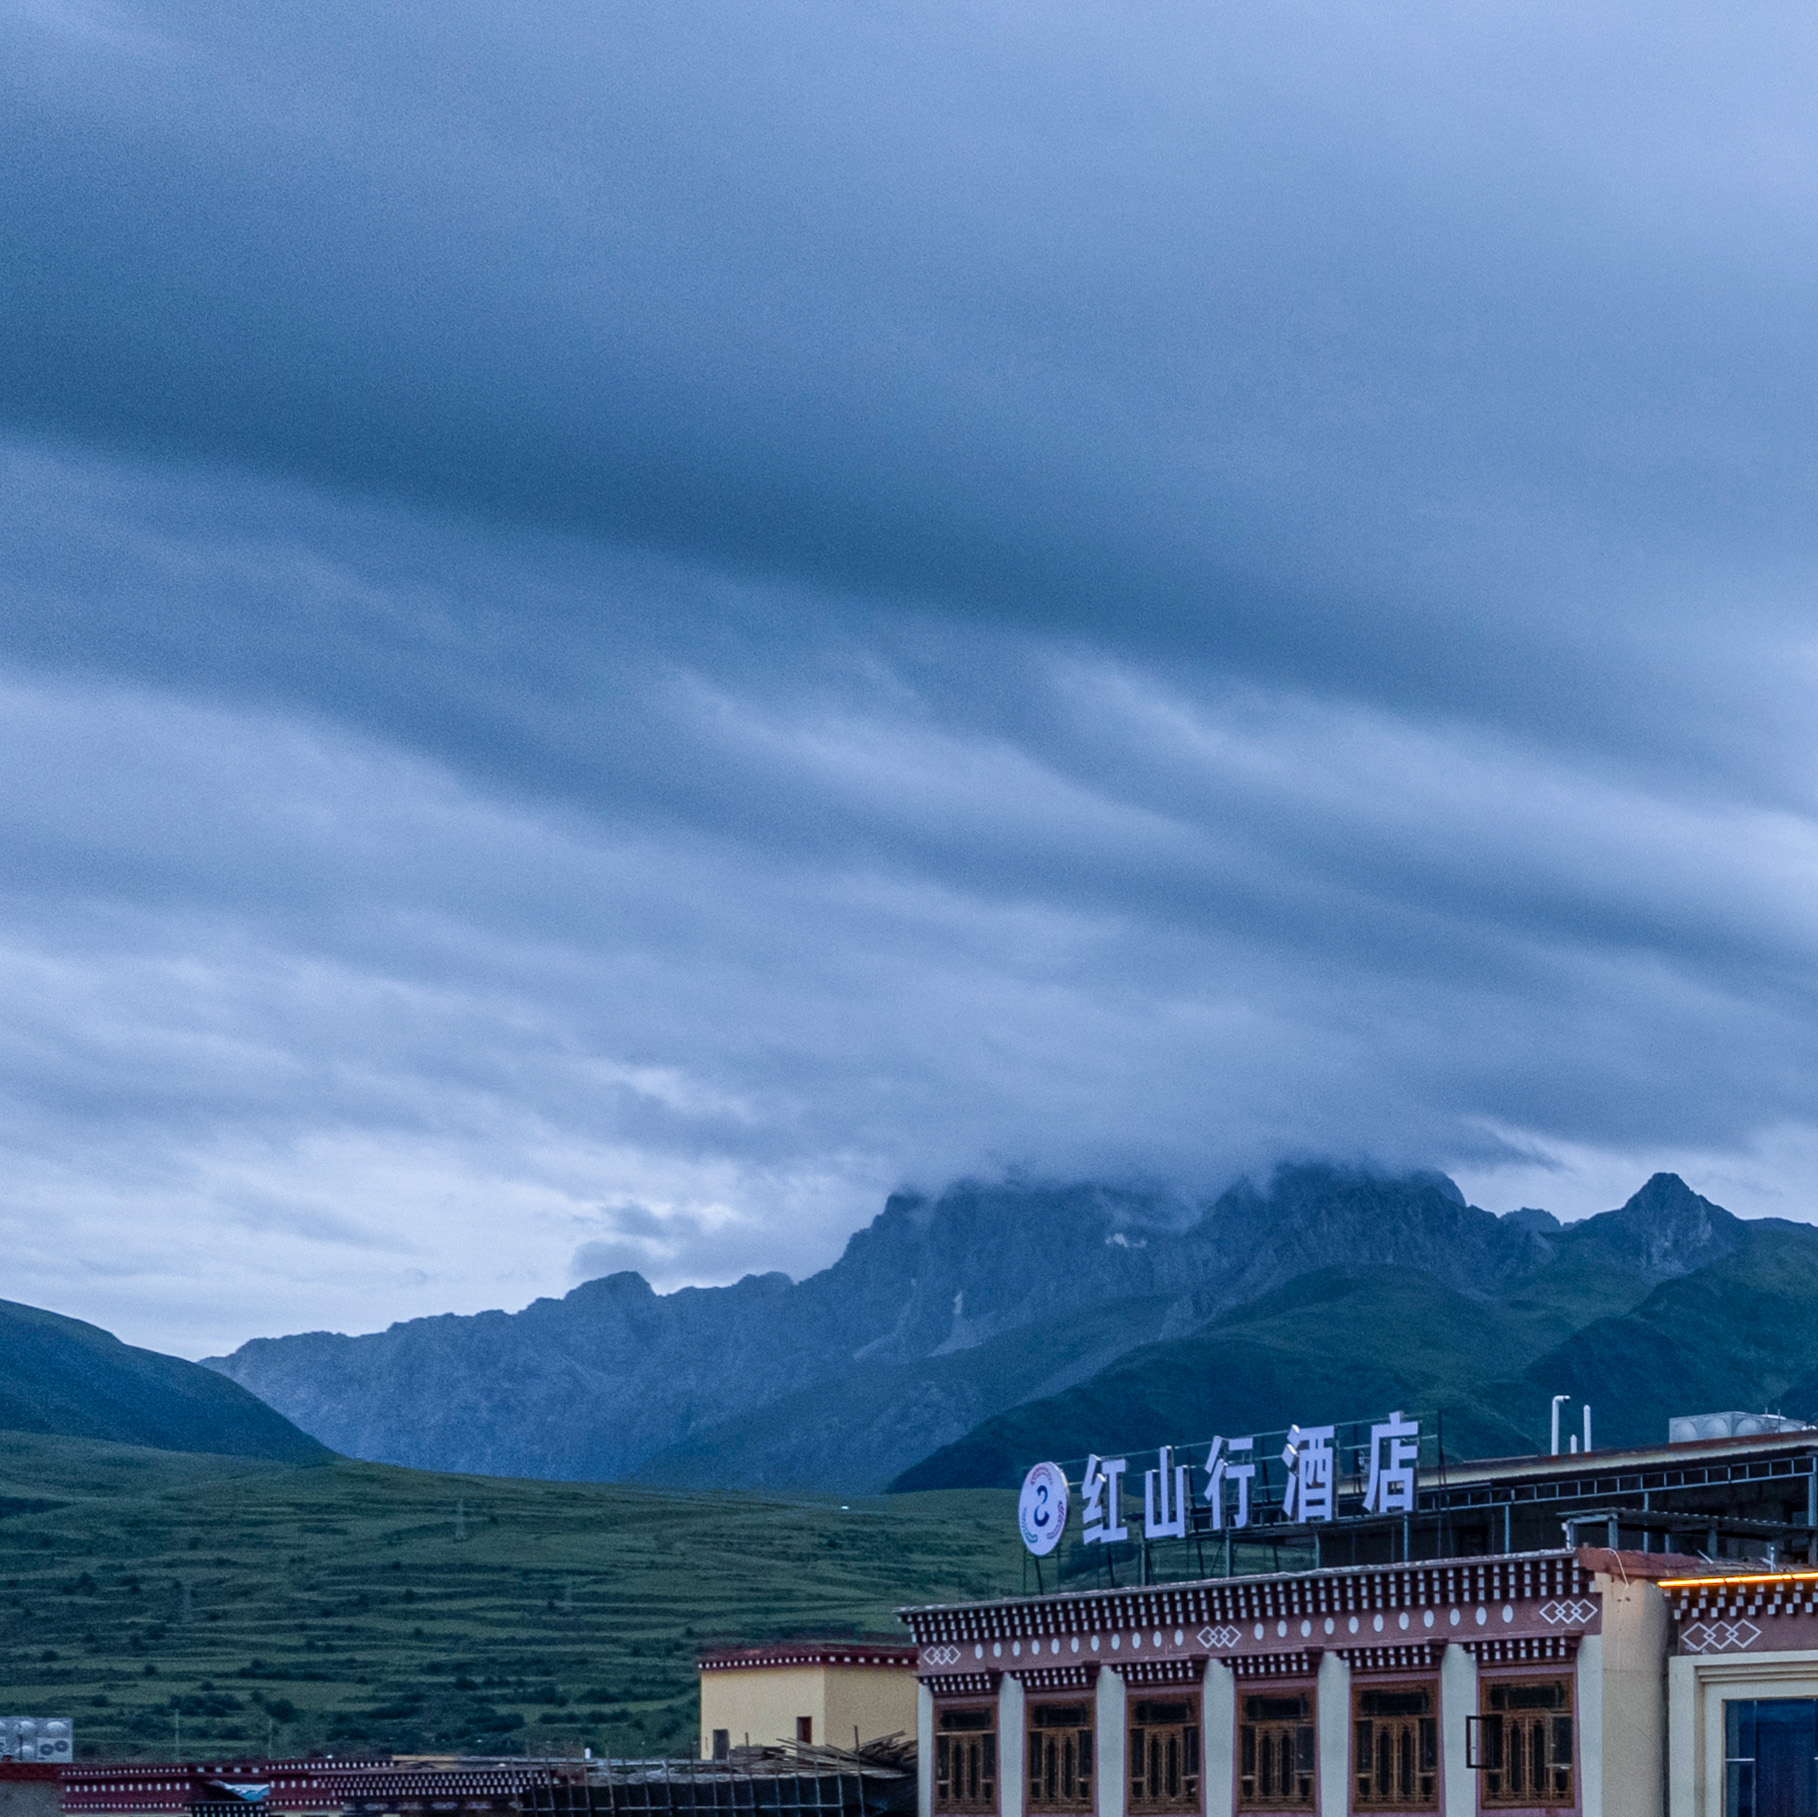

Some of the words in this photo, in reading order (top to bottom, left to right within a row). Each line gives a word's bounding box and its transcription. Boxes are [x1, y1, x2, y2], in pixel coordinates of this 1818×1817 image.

[1082, 1410, 1420, 1544] 红山行酒店
